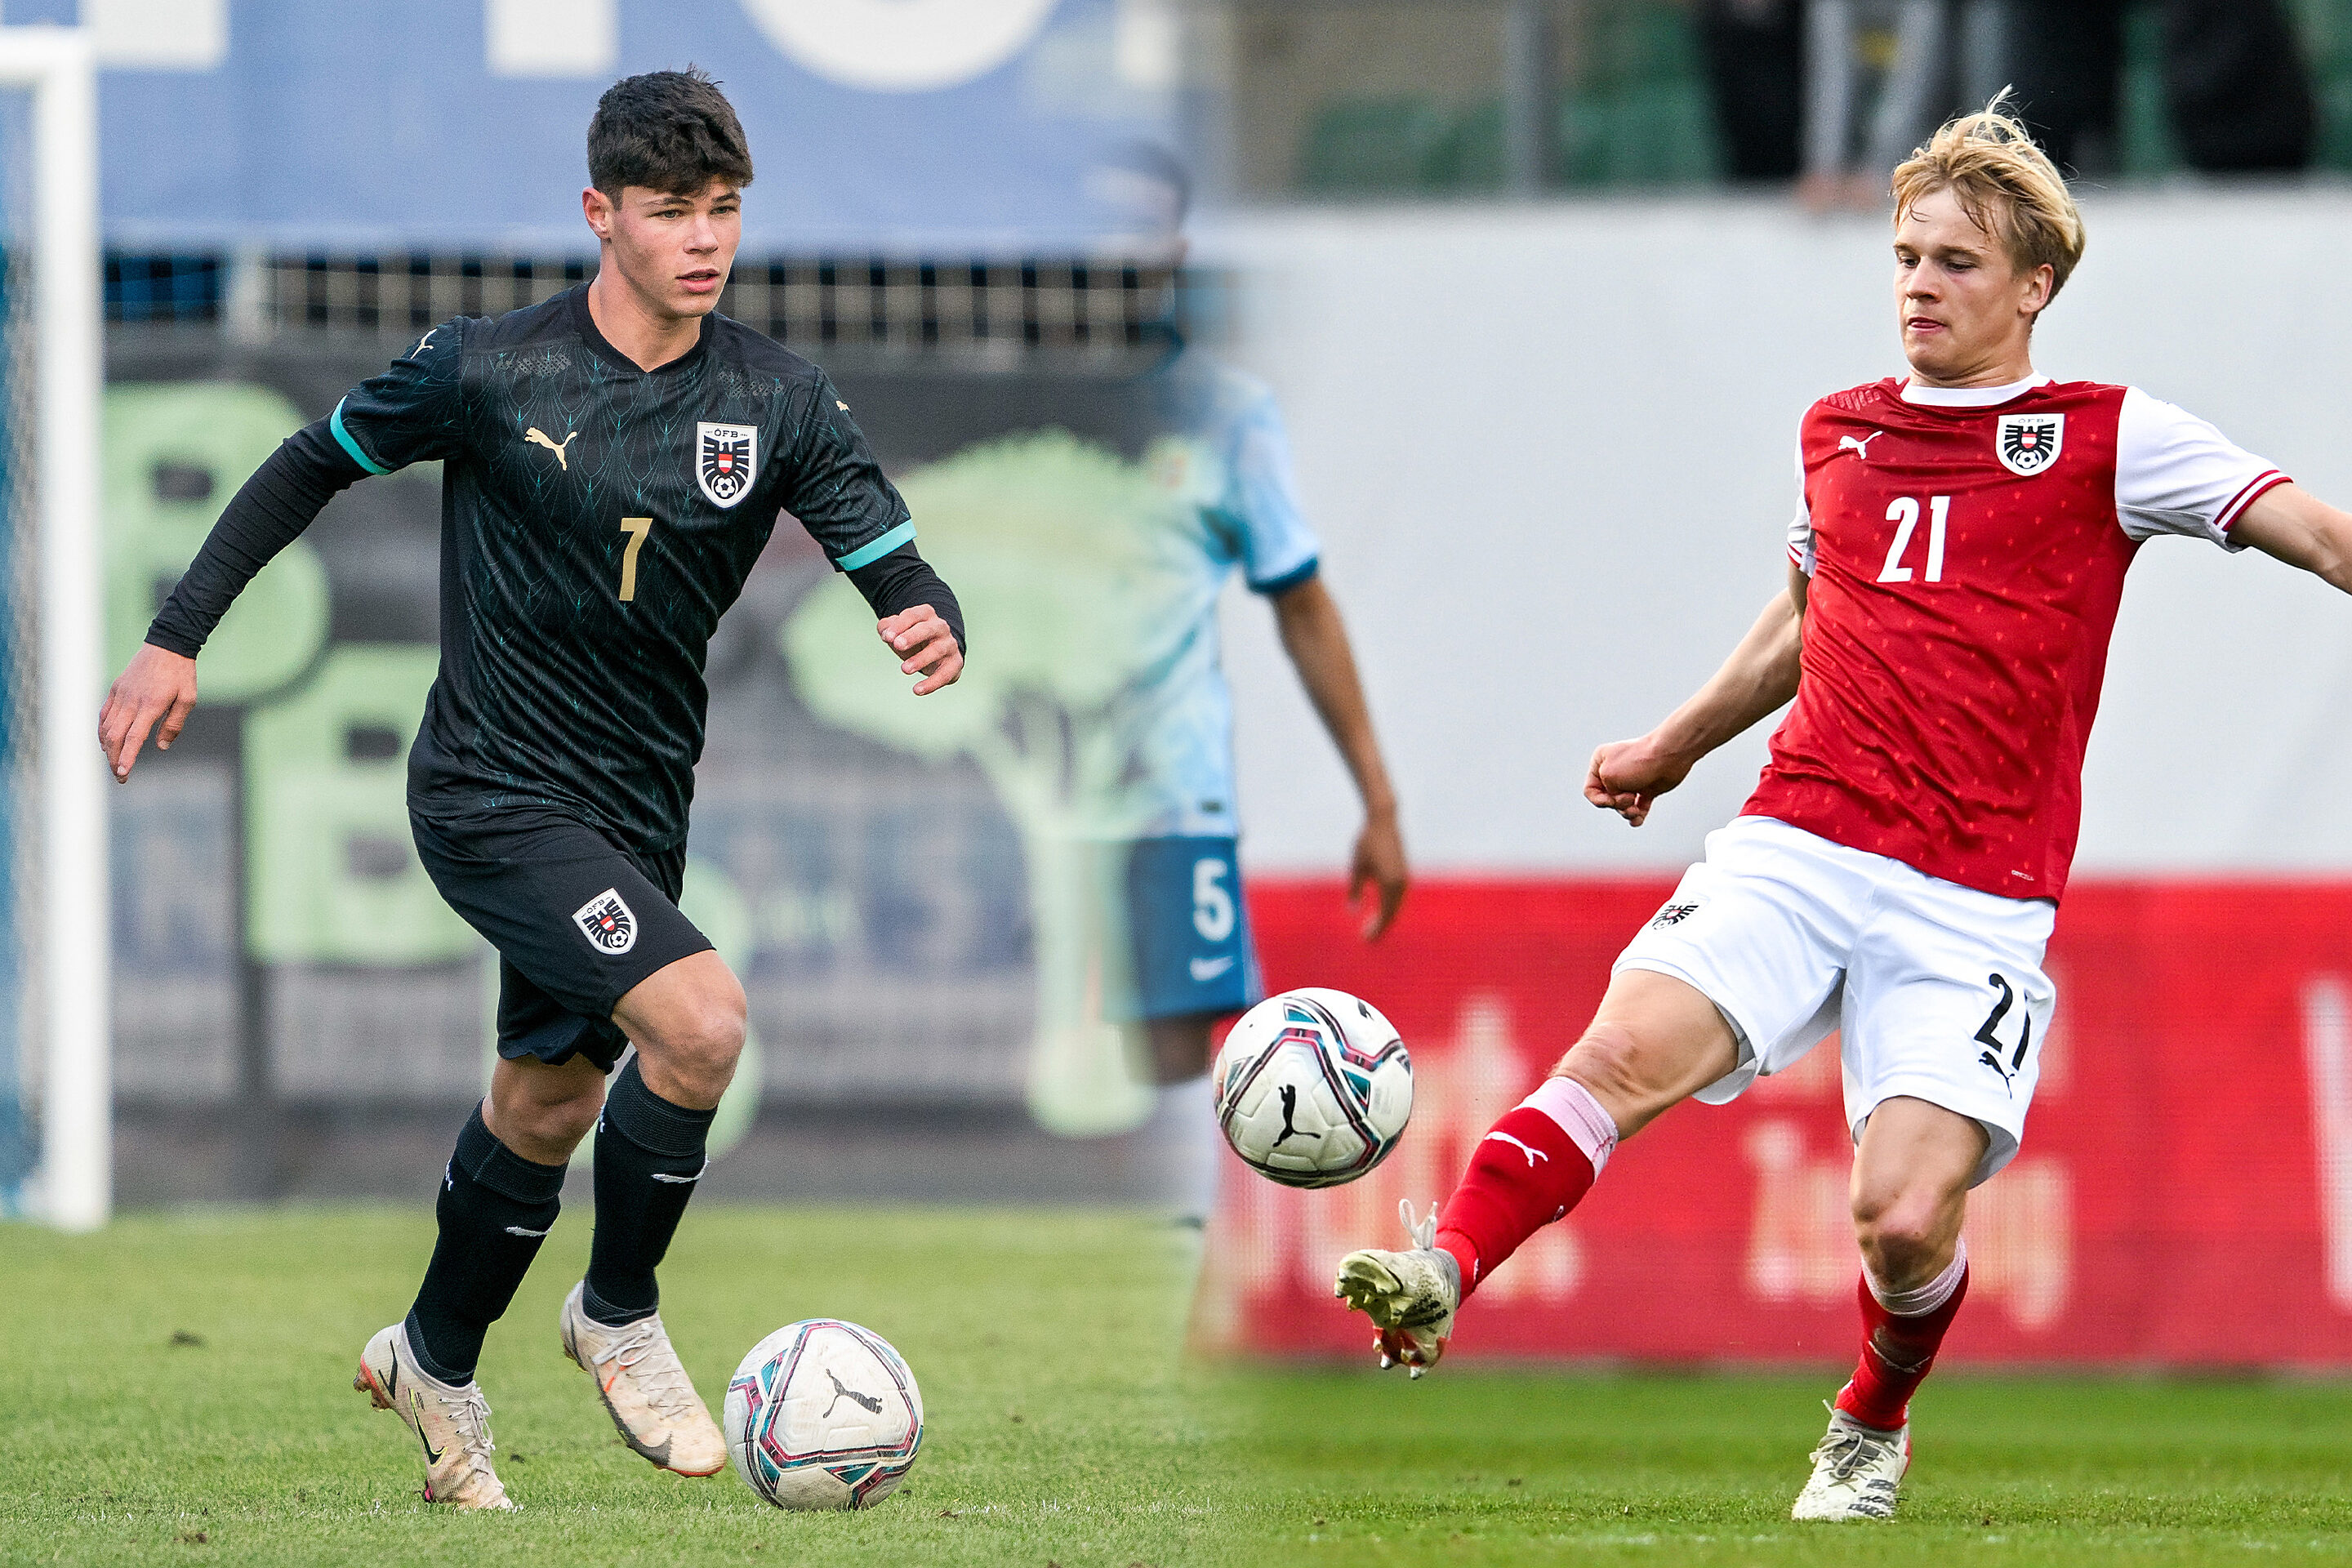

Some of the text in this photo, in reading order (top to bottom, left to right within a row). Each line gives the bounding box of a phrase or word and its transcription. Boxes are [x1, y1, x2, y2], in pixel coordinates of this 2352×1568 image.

[714, 427, 738, 439] ÖFB
[618, 517, 653, 602] 7
[1876, 496, 1951, 582] 21
[1192, 858, 1235, 942] 5
[1973, 973, 2031, 1071] 21
